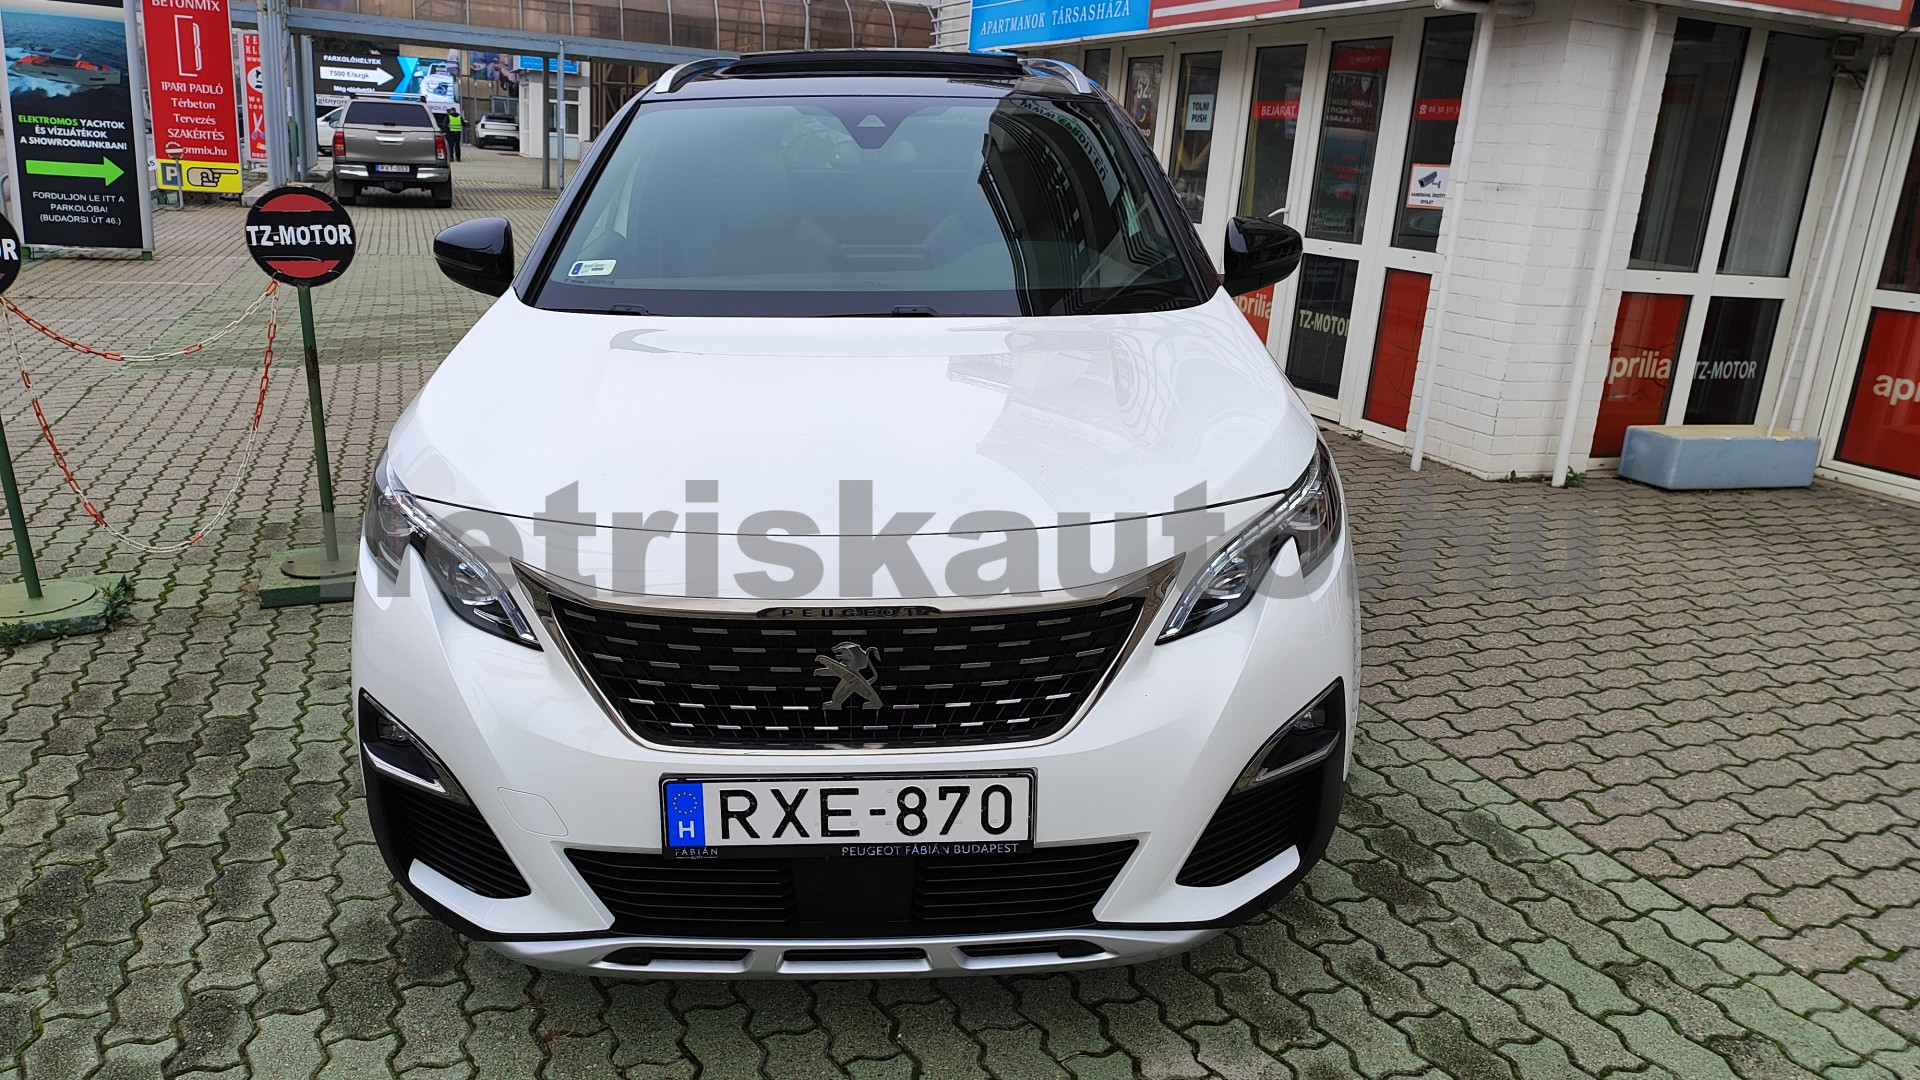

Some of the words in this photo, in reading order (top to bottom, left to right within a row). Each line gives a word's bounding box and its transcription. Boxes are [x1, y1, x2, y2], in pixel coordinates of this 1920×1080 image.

[980, 12, 1046, 36] APARTMANOK
[1052, 0, 1130, 26] TÁRSASHÁZA
[245, 45, 260, 55] KL
[161, 81, 186, 93] IPARI
[189, 83, 224, 95] PADLÓ
[171, 98, 216, 110] Térbeton
[1192, 102, 1209, 111] TOLNI
[1261, 103, 1296, 116] BEJÁRAT
[18, 114, 78, 126] ELEKTROMOS
[79, 119, 125, 129] YACHTOK
[173, 113, 216, 125] Tervezés
[1190, 114, 1207, 123] PUSH
[35, 125, 46, 134] ÉS
[167, 127, 225, 141] SZAKÉRTÉS
[20, 136, 27, 144] A
[29, 136, 128, 150] SHOWROOMUNKBAN!
[183, 145, 228, 156] onmix.hu
[32, 191, 87, 202] FORDULJON
[88, 194, 100, 202] LE
[50, 203, 108, 213] PARKOLÓBA!
[91, 214, 103, 224] ÚT
[105, 217, 122, 226] 46.)
[246, 224, 353, 247] TZ-MOTOR
[0, 238, 19, 260] R
[1233, 293, 1272, 320] prilia
[1608, 350, 1671, 384] prilia
[781, 607, 917, 618] PEUGEOT
[719, 784, 1013, 840] RXE-870
[679, 820, 695, 838] H
[674, 846, 718, 856] FÁBIÁN
[841, 845, 901, 856] PEUGEOT
[905, 844, 950, 855] FÁBIÁN
[953, 843, 1019, 854] BUDAPEST
